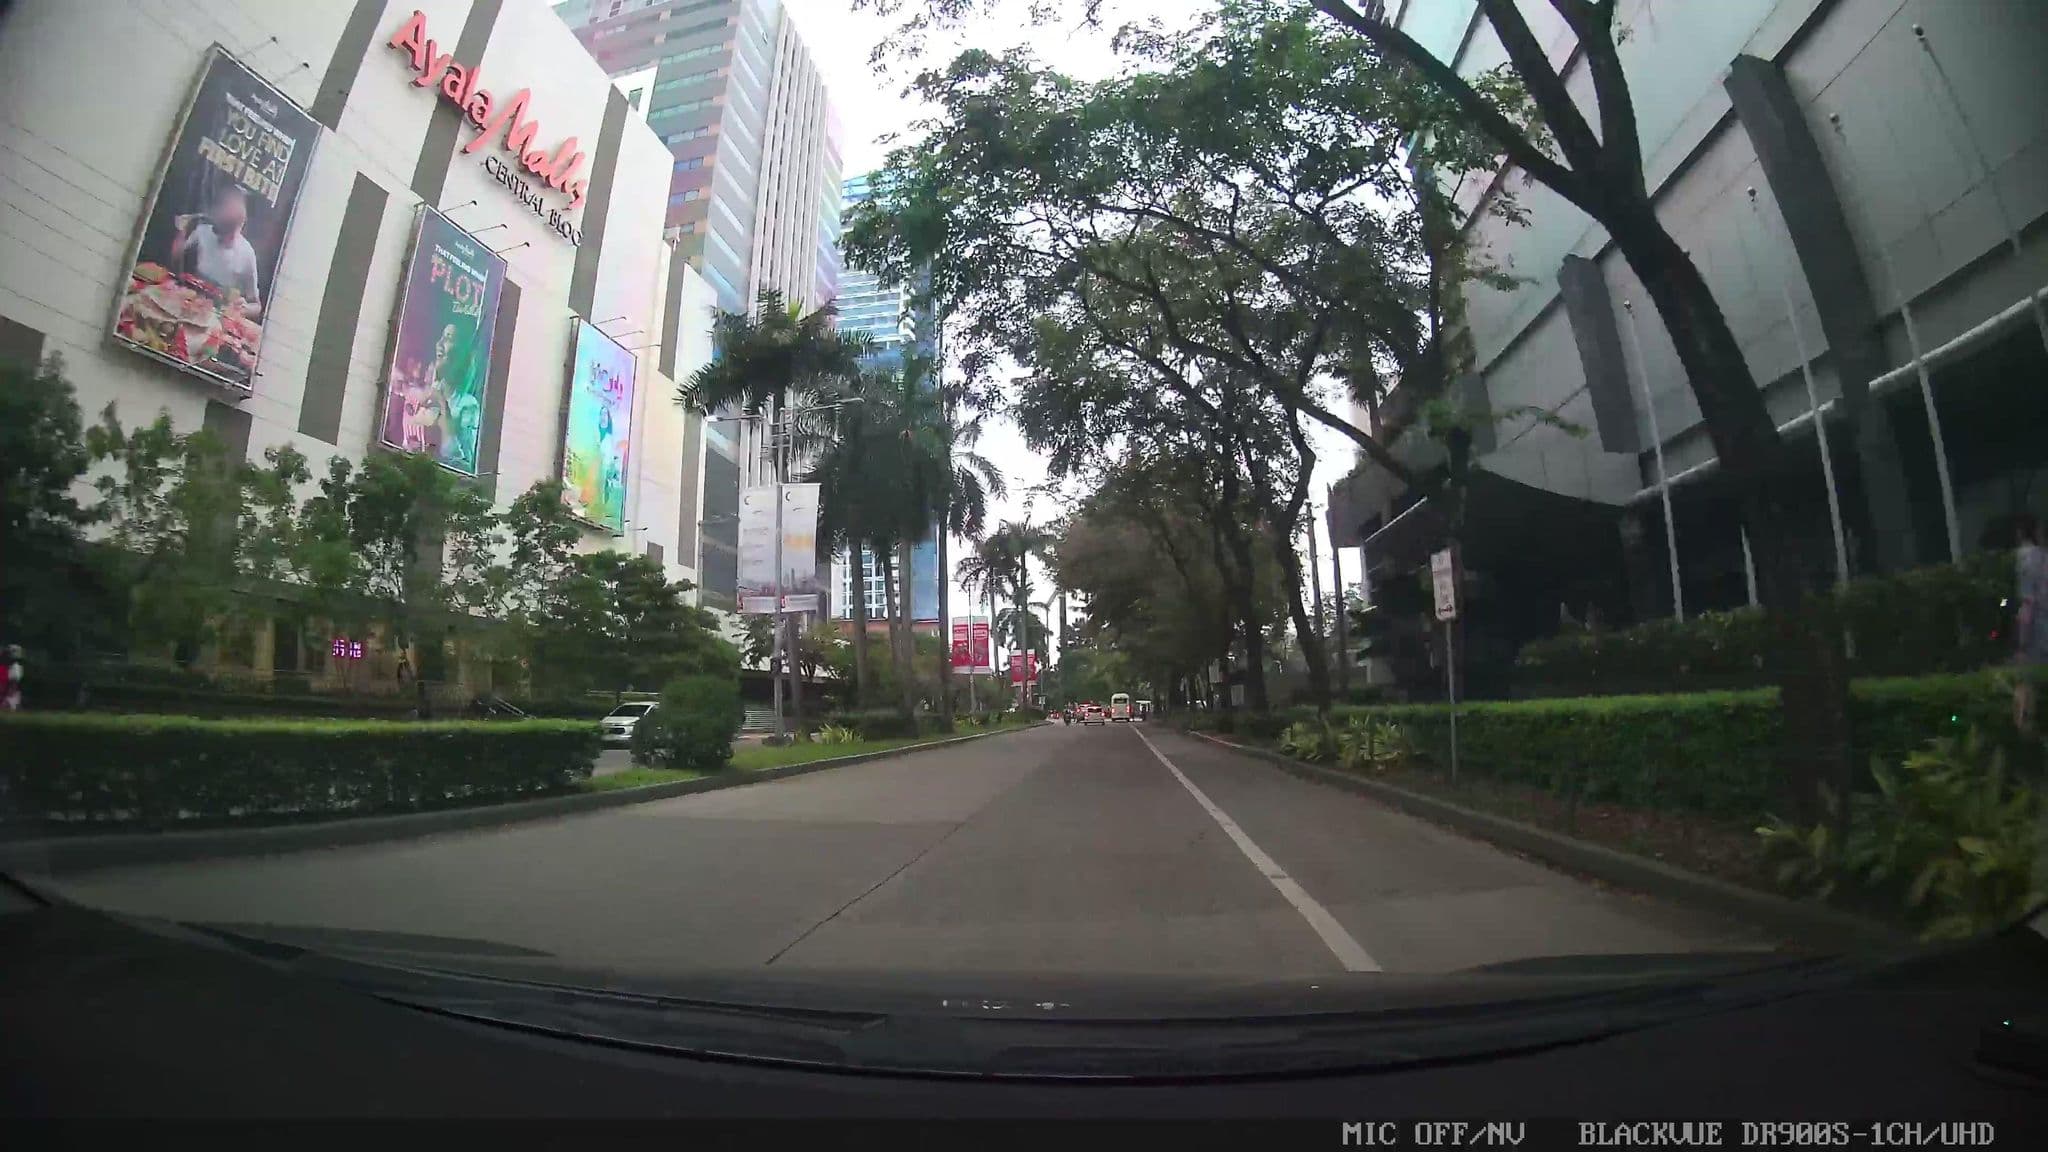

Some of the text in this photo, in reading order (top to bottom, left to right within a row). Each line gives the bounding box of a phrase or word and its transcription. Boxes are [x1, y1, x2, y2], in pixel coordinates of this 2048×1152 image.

[227, 108, 257, 140] YOU
[386, 10, 587, 211] Ayala Malls
[219, 127, 261, 169] LOVE
[484, 154, 583, 247] CENTRAL BLOC
[430, 254, 485, 305] PLOT
